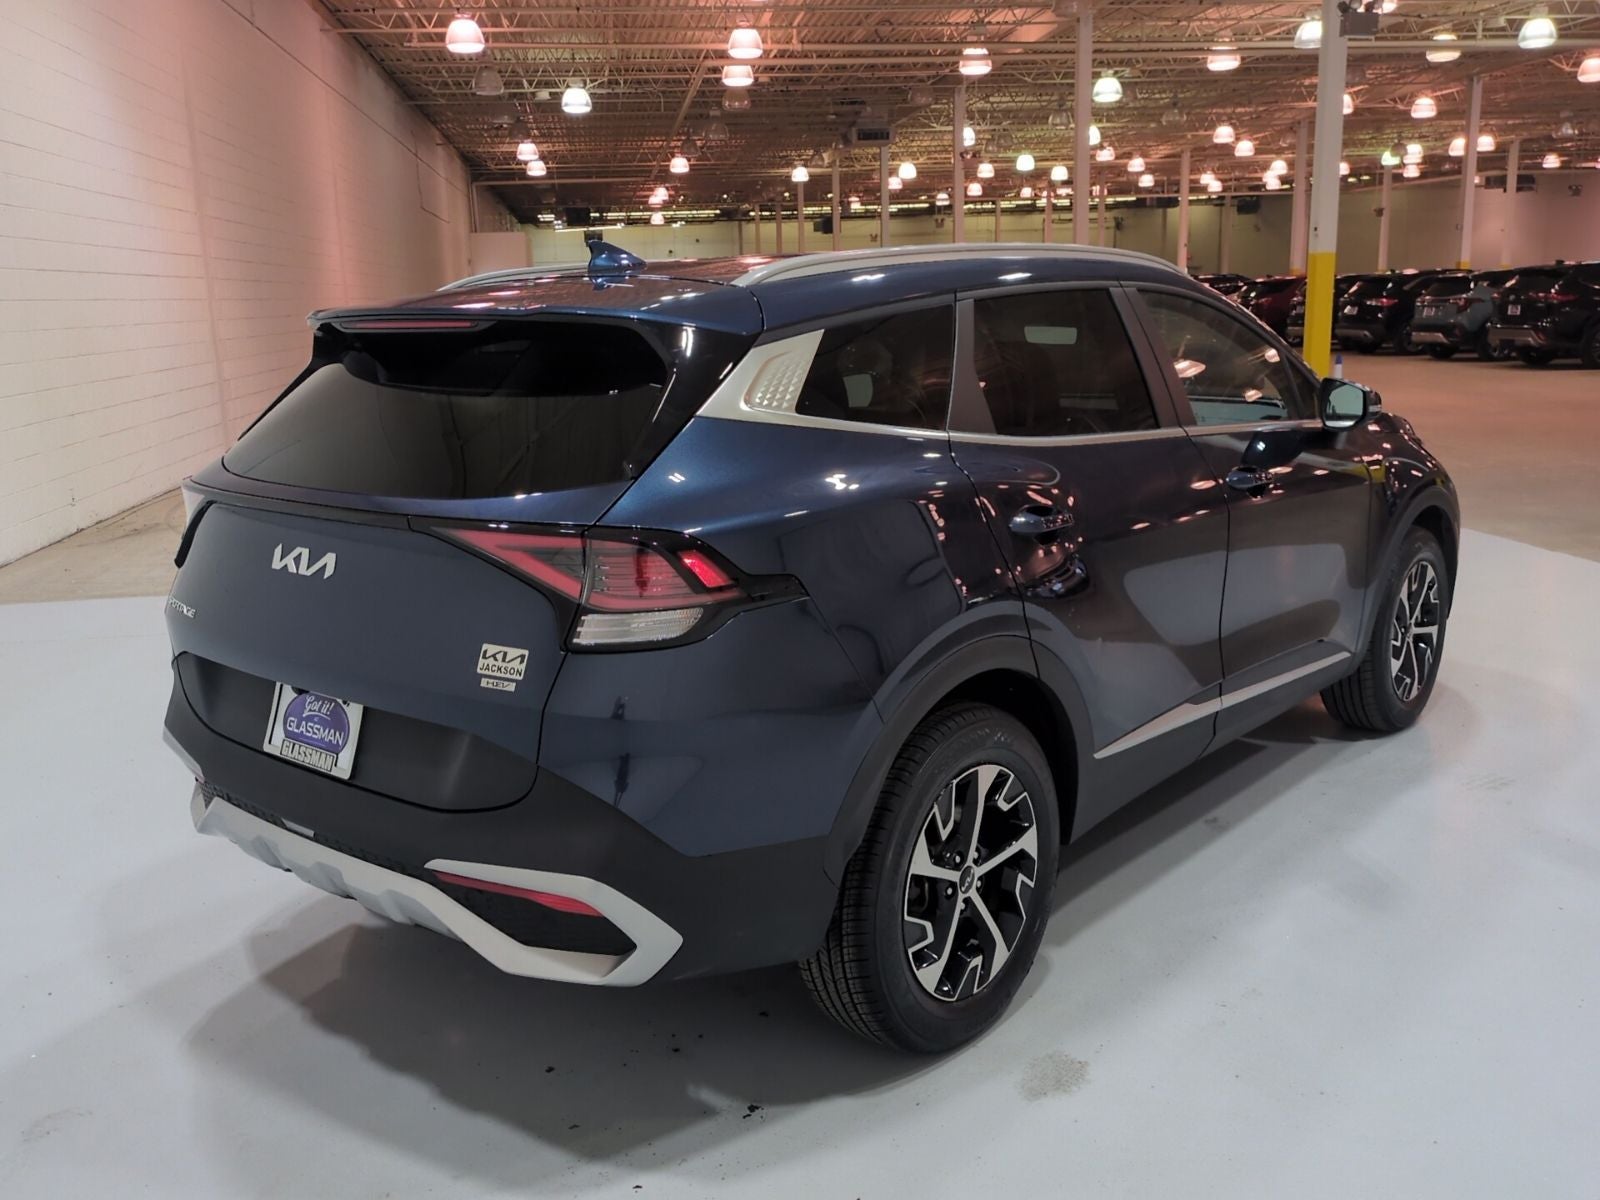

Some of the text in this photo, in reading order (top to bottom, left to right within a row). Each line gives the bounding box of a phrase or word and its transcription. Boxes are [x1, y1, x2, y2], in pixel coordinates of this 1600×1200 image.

[271, 543, 337, 580] KIA
[481, 648, 527, 665] KIA
[479, 663, 523, 677] JACKSON
[303, 695, 335, 715] Got it!
[286, 717, 344, 746] GLASSMAN
[281, 739, 333, 771] GLASSMAN
